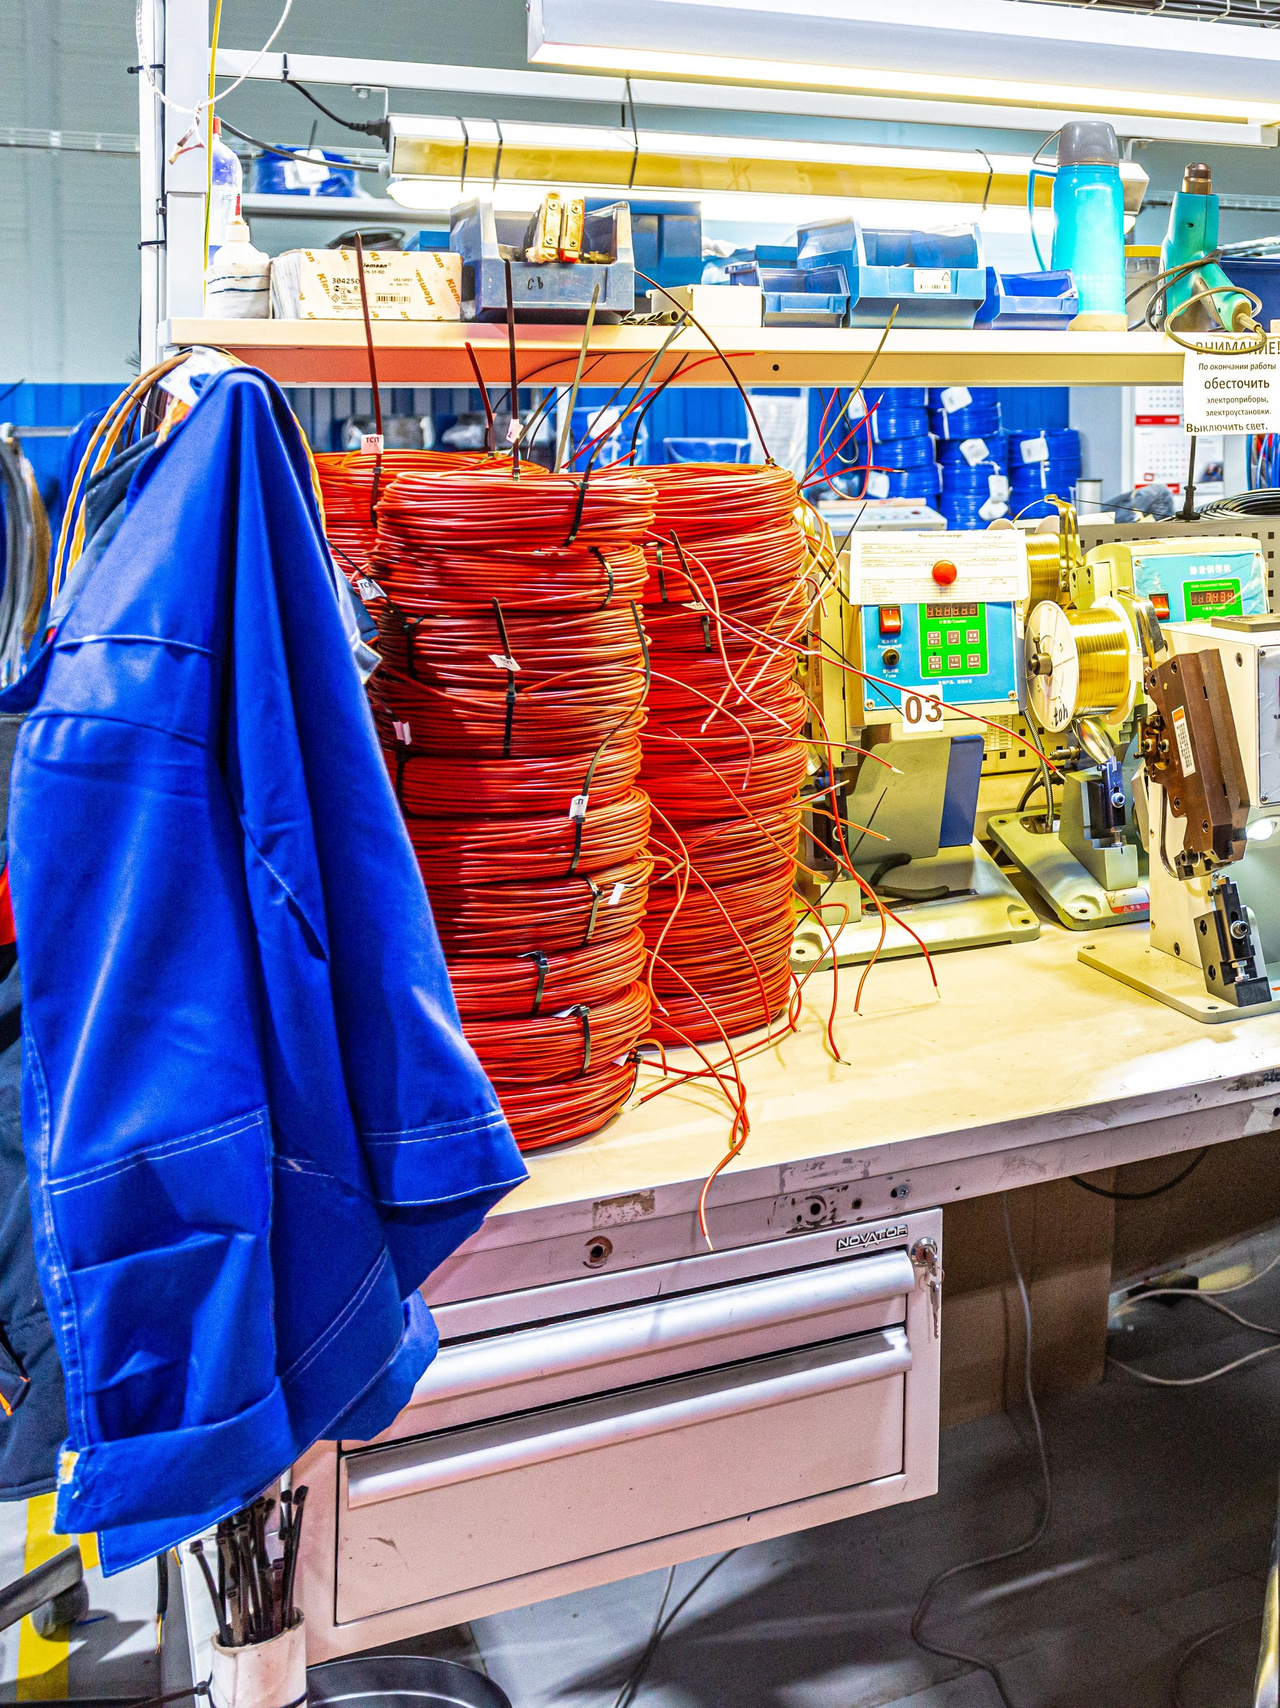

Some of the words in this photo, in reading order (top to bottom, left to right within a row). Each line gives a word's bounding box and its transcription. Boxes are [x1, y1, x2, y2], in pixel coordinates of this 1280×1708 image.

[1198, 363, 1208, 371] По
[1210, 363, 1249, 371] окончании
[1250, 362, 1277, 372] работы
[1204, 377, 1270, 390] обесточить
[1207, 395, 1269, 405] электроприборы,
[1206, 409, 1272, 418] электроустановки.
[1186, 423, 1244, 433] Выключить
[1246, 422, 1268, 431] свет.
[905, 694, 942, 724] 03
[836, 1224, 909, 1252] NOVATOR
